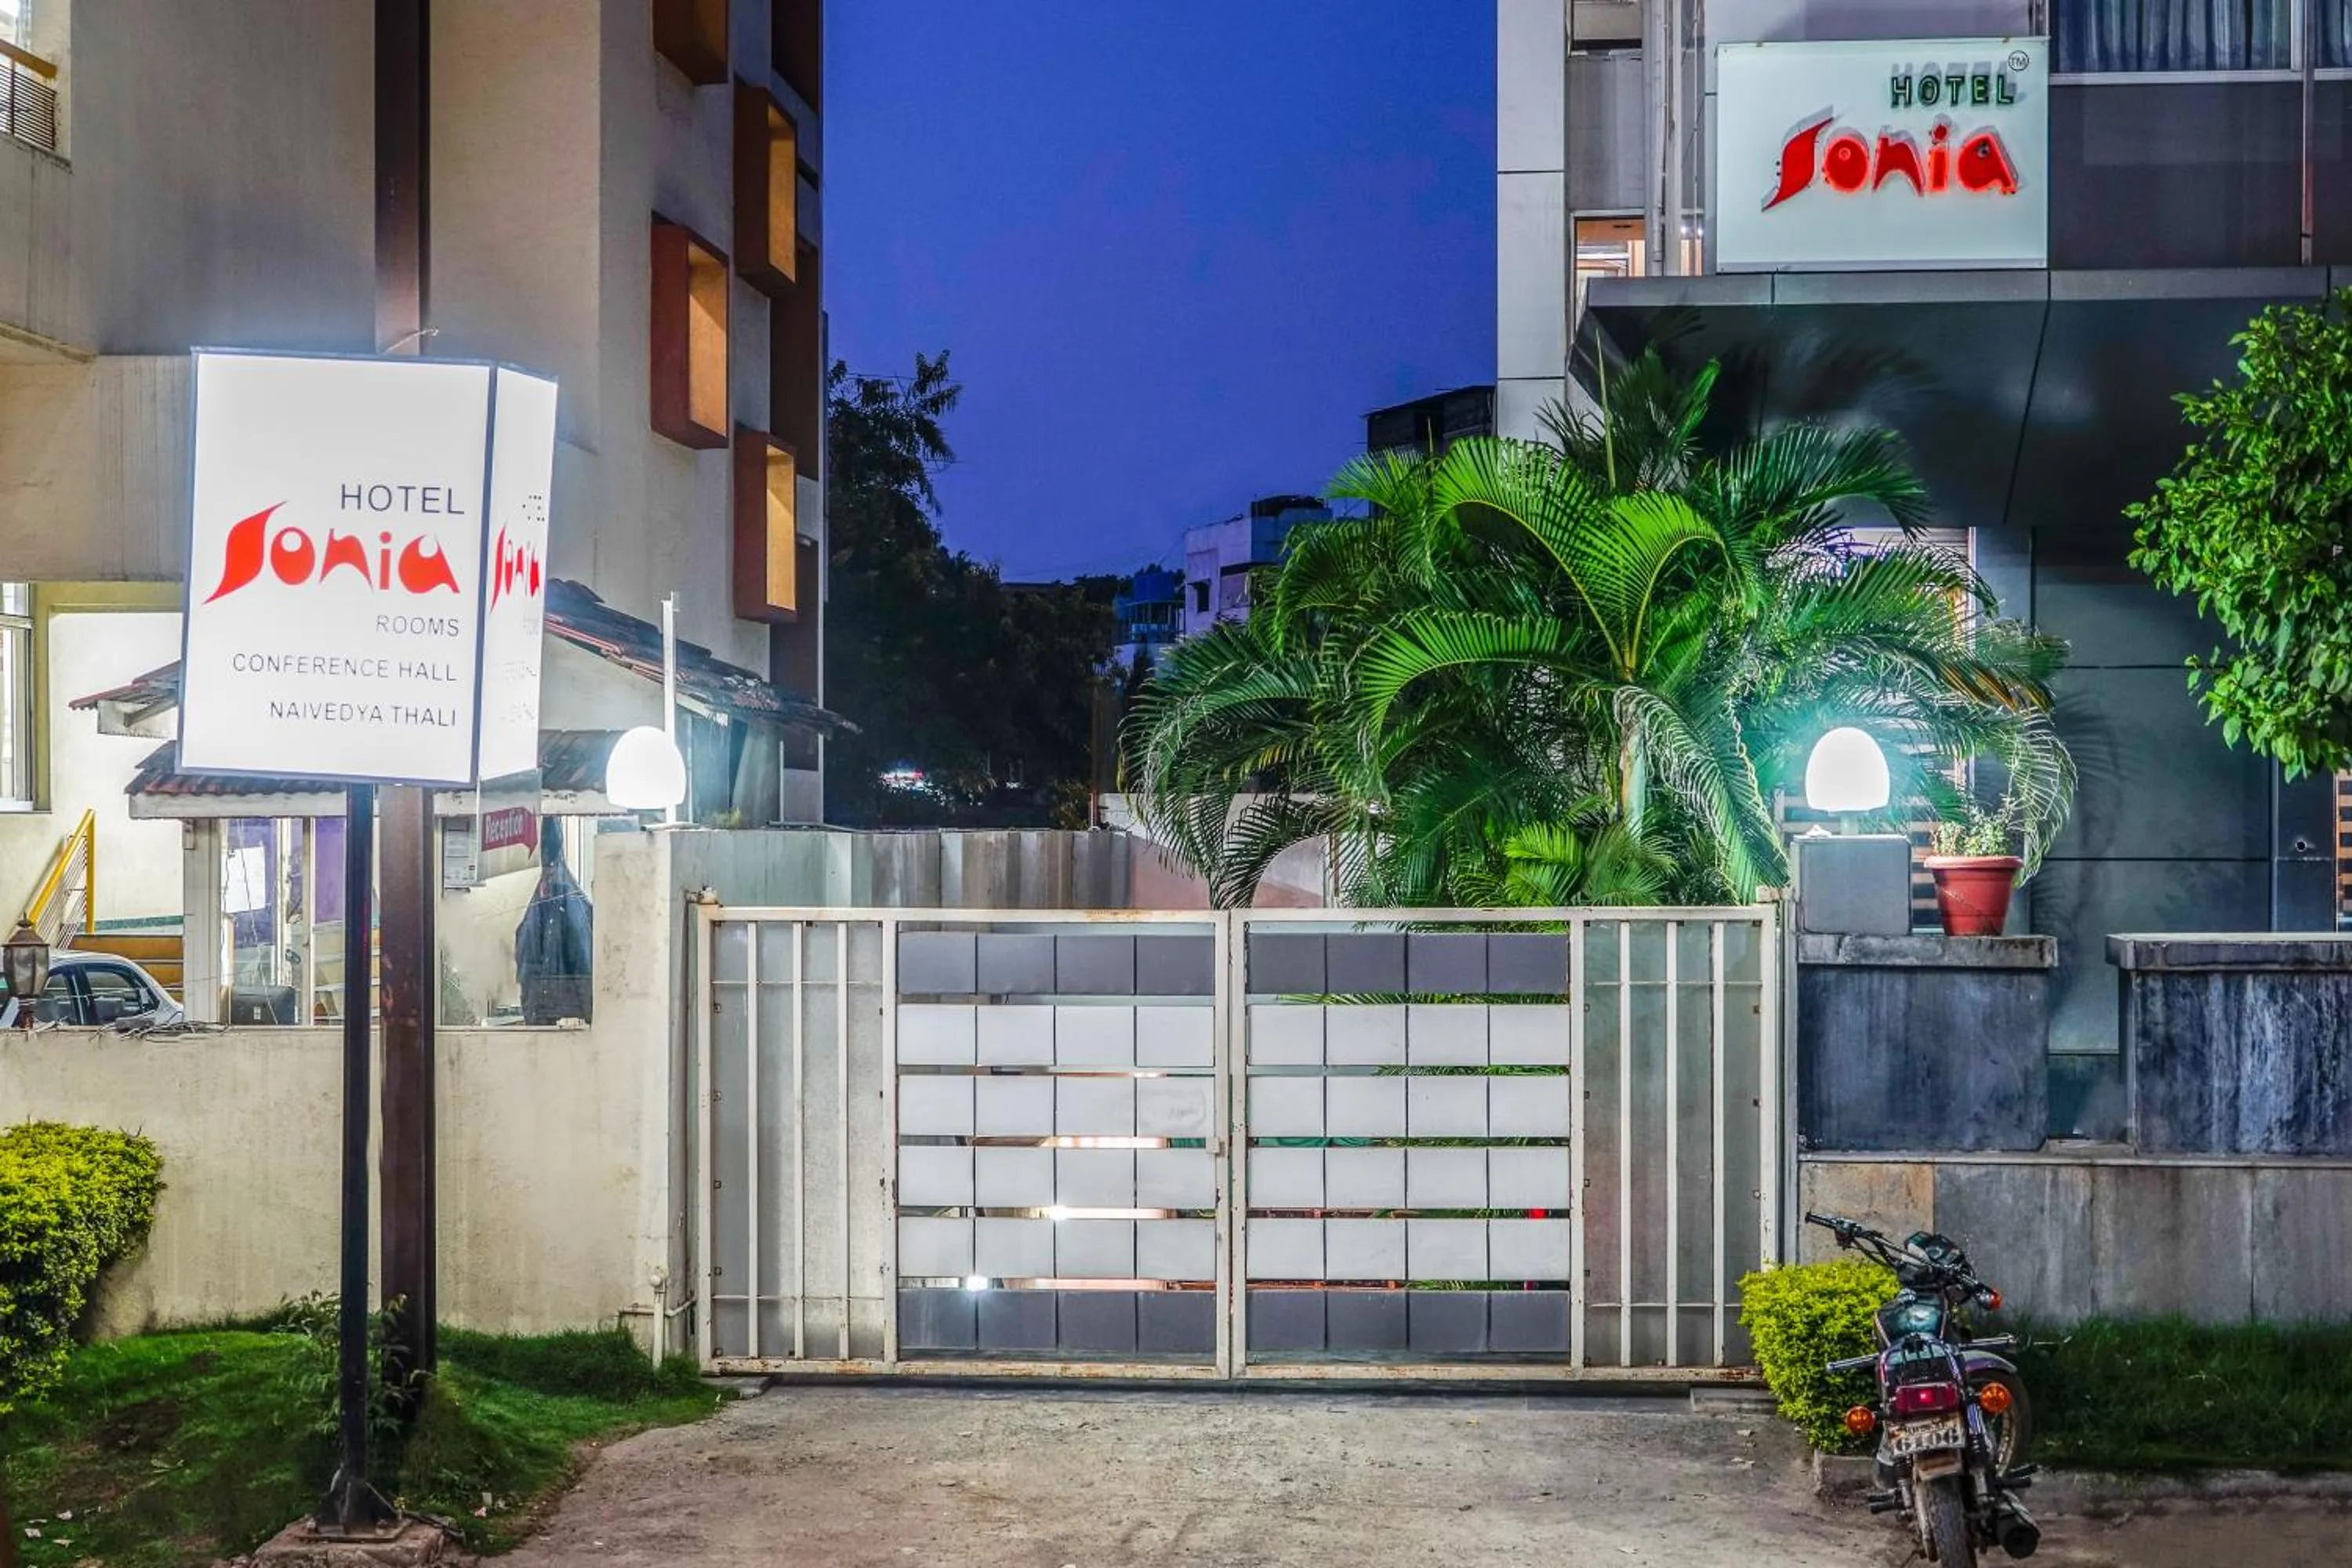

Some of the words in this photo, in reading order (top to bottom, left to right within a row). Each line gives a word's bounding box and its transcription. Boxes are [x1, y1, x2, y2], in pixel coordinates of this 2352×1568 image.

[1890, 74, 2016, 108] HOTEL
[1761, 117, 2018, 212] Sonia
[340, 483, 465, 515] HOTEL
[200, 499, 461, 605] Sonia
[376, 614, 460, 638] ROOMS
[232, 652, 390, 679] CONFERENCE
[398, 658, 458, 682] HALL
[270, 700, 383, 724] NAIVEDYA
[390, 704, 457, 728] THALI
[485, 811, 524, 842] Reception
